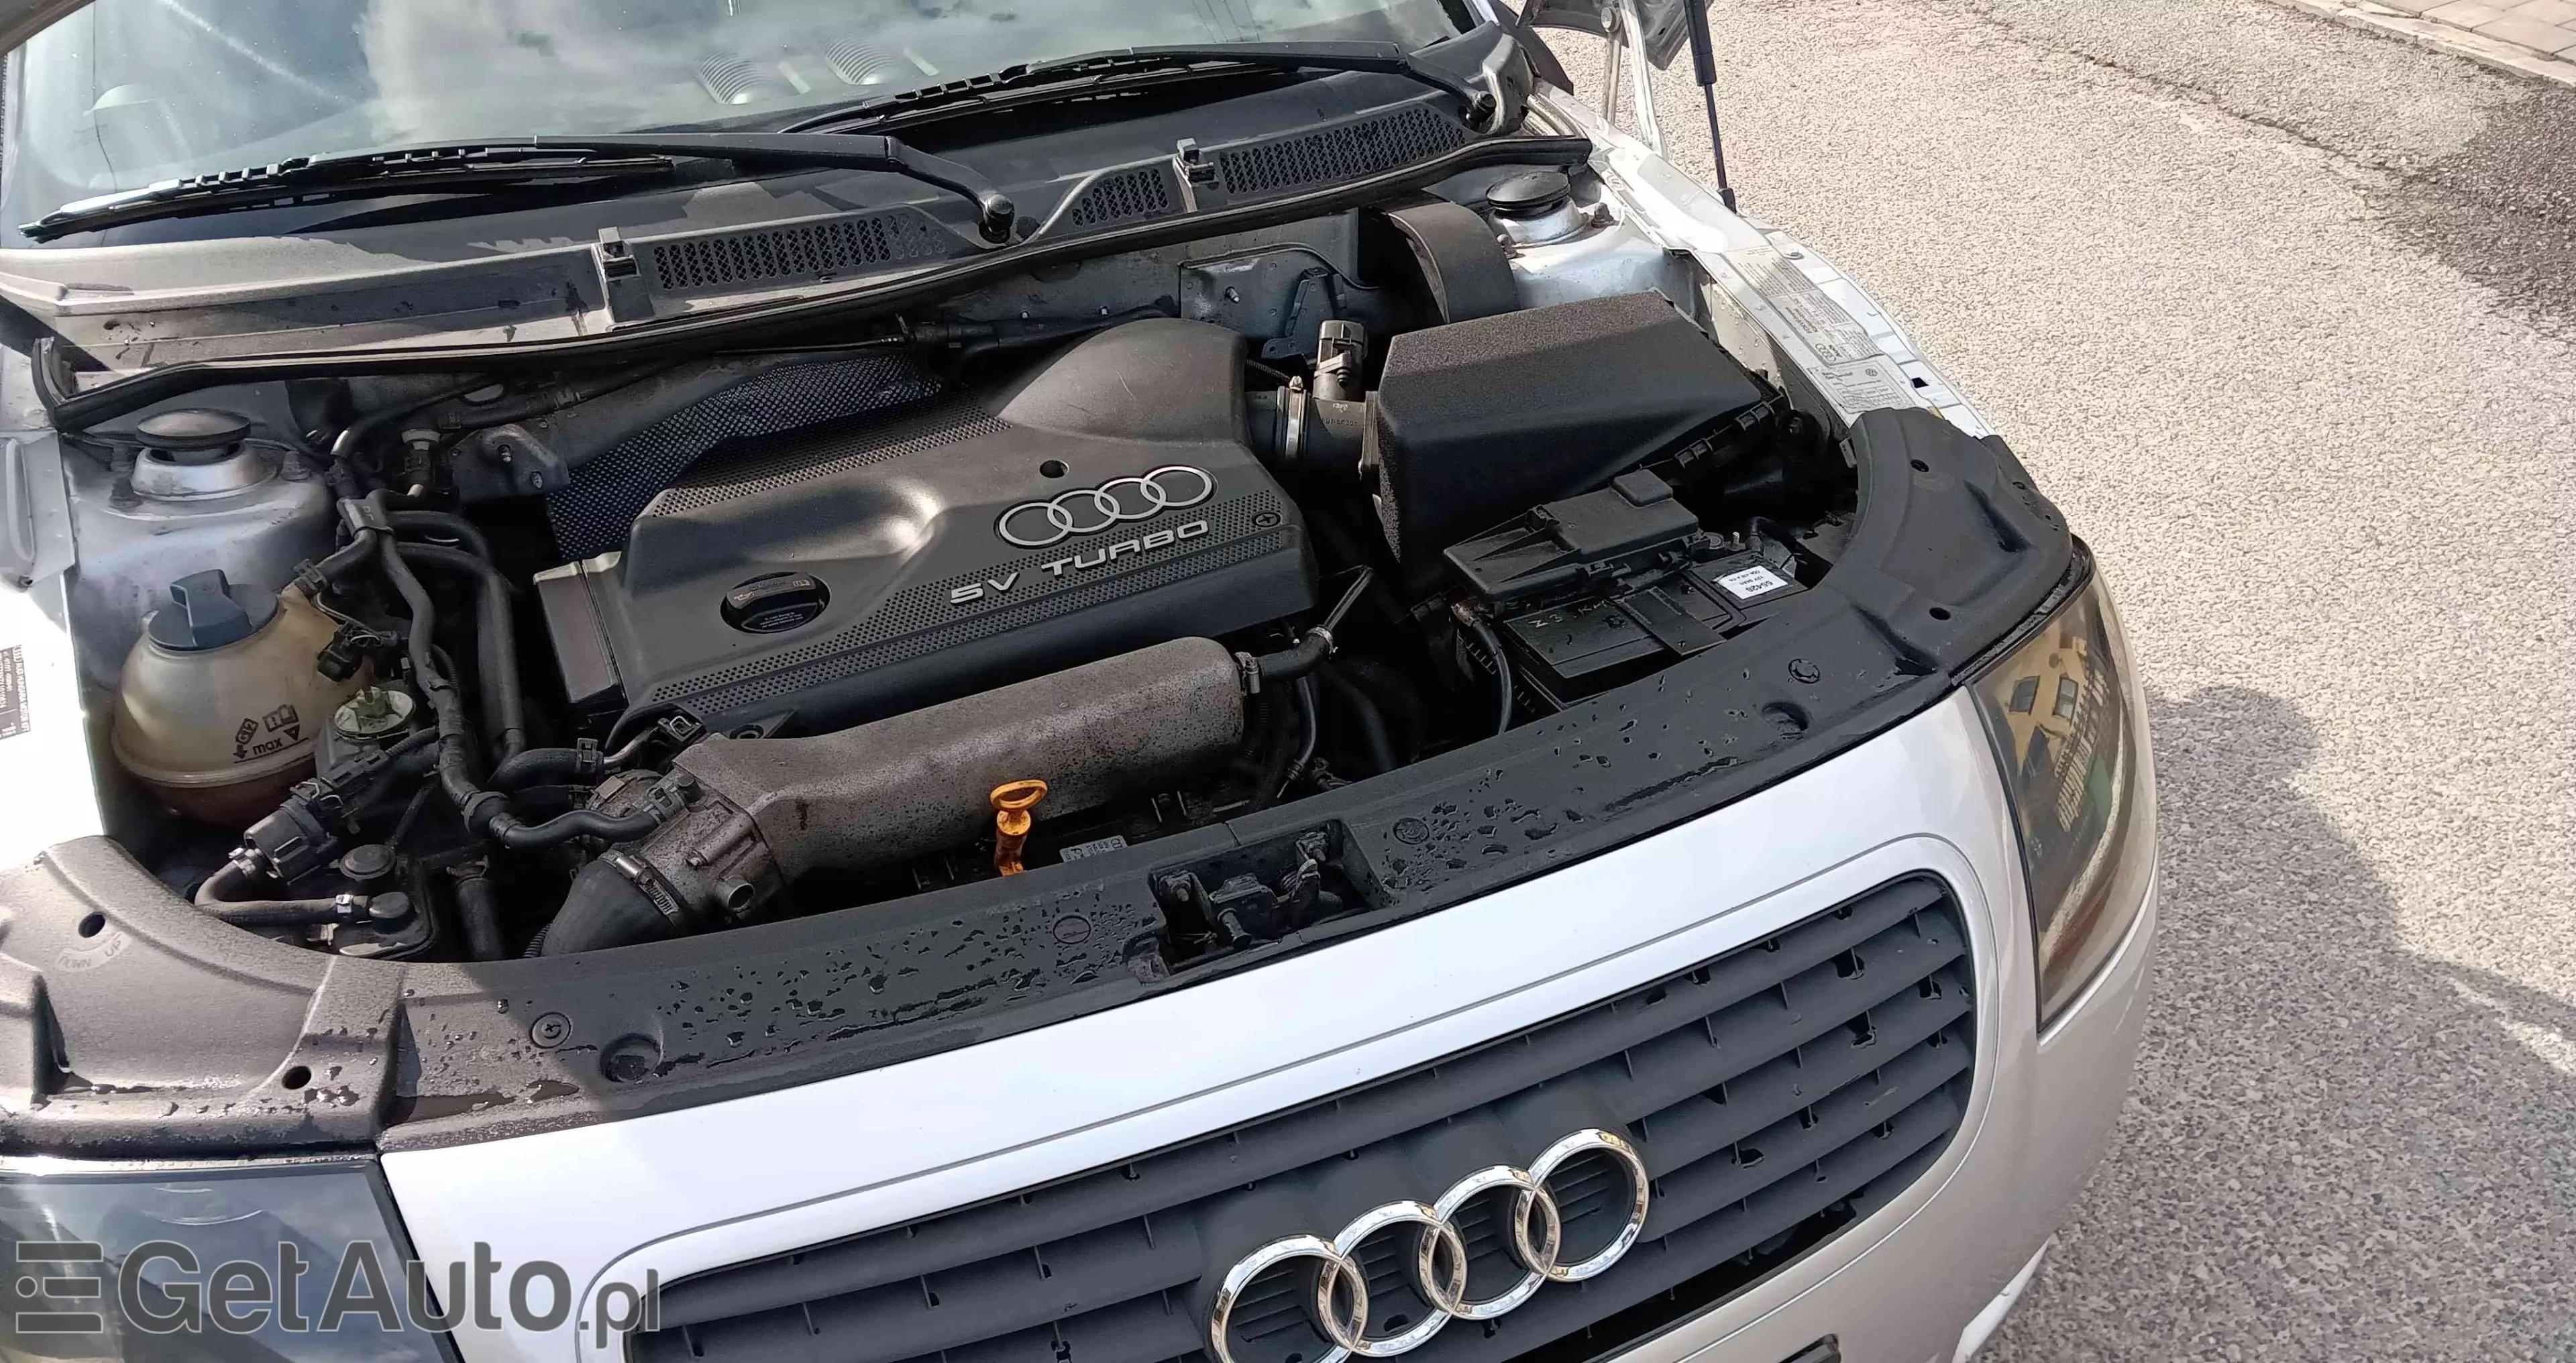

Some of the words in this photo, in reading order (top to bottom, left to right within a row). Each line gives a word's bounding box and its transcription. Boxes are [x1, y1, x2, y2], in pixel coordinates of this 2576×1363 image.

[950, 571, 1020, 604] 5V
[1040, 520, 1208, 576] TURBO
[237, 720, 257, 743] G12
[252, 738, 282, 755] max
